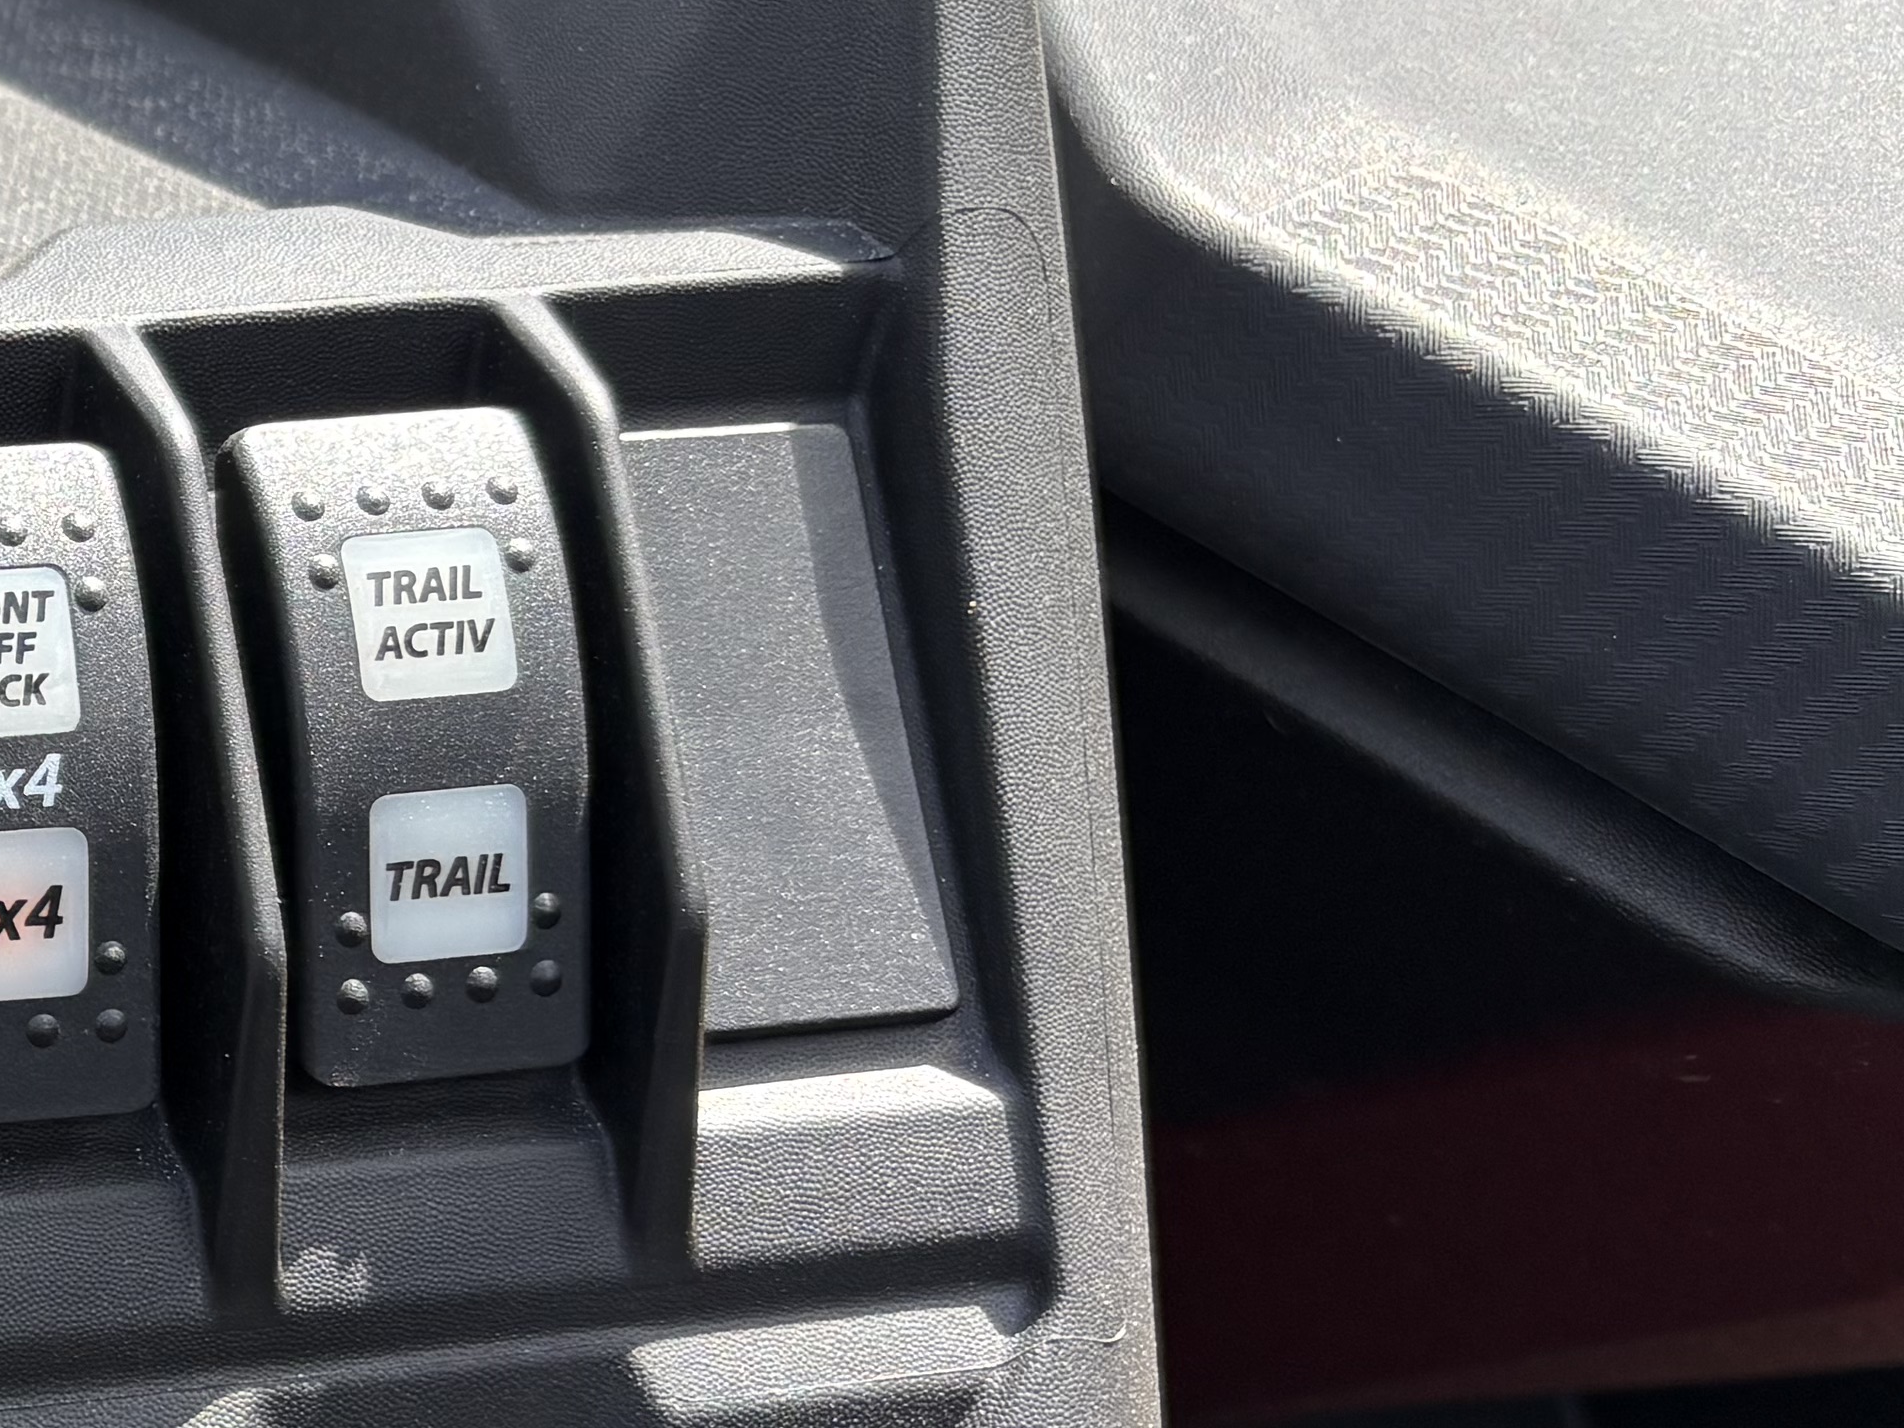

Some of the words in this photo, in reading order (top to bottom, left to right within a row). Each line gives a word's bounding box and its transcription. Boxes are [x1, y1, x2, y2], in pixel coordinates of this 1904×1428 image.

[366, 565, 483, 608] TRAIL
[375, 618, 495, 662] ACTIV
[385, 853, 511, 903] TRAIL
